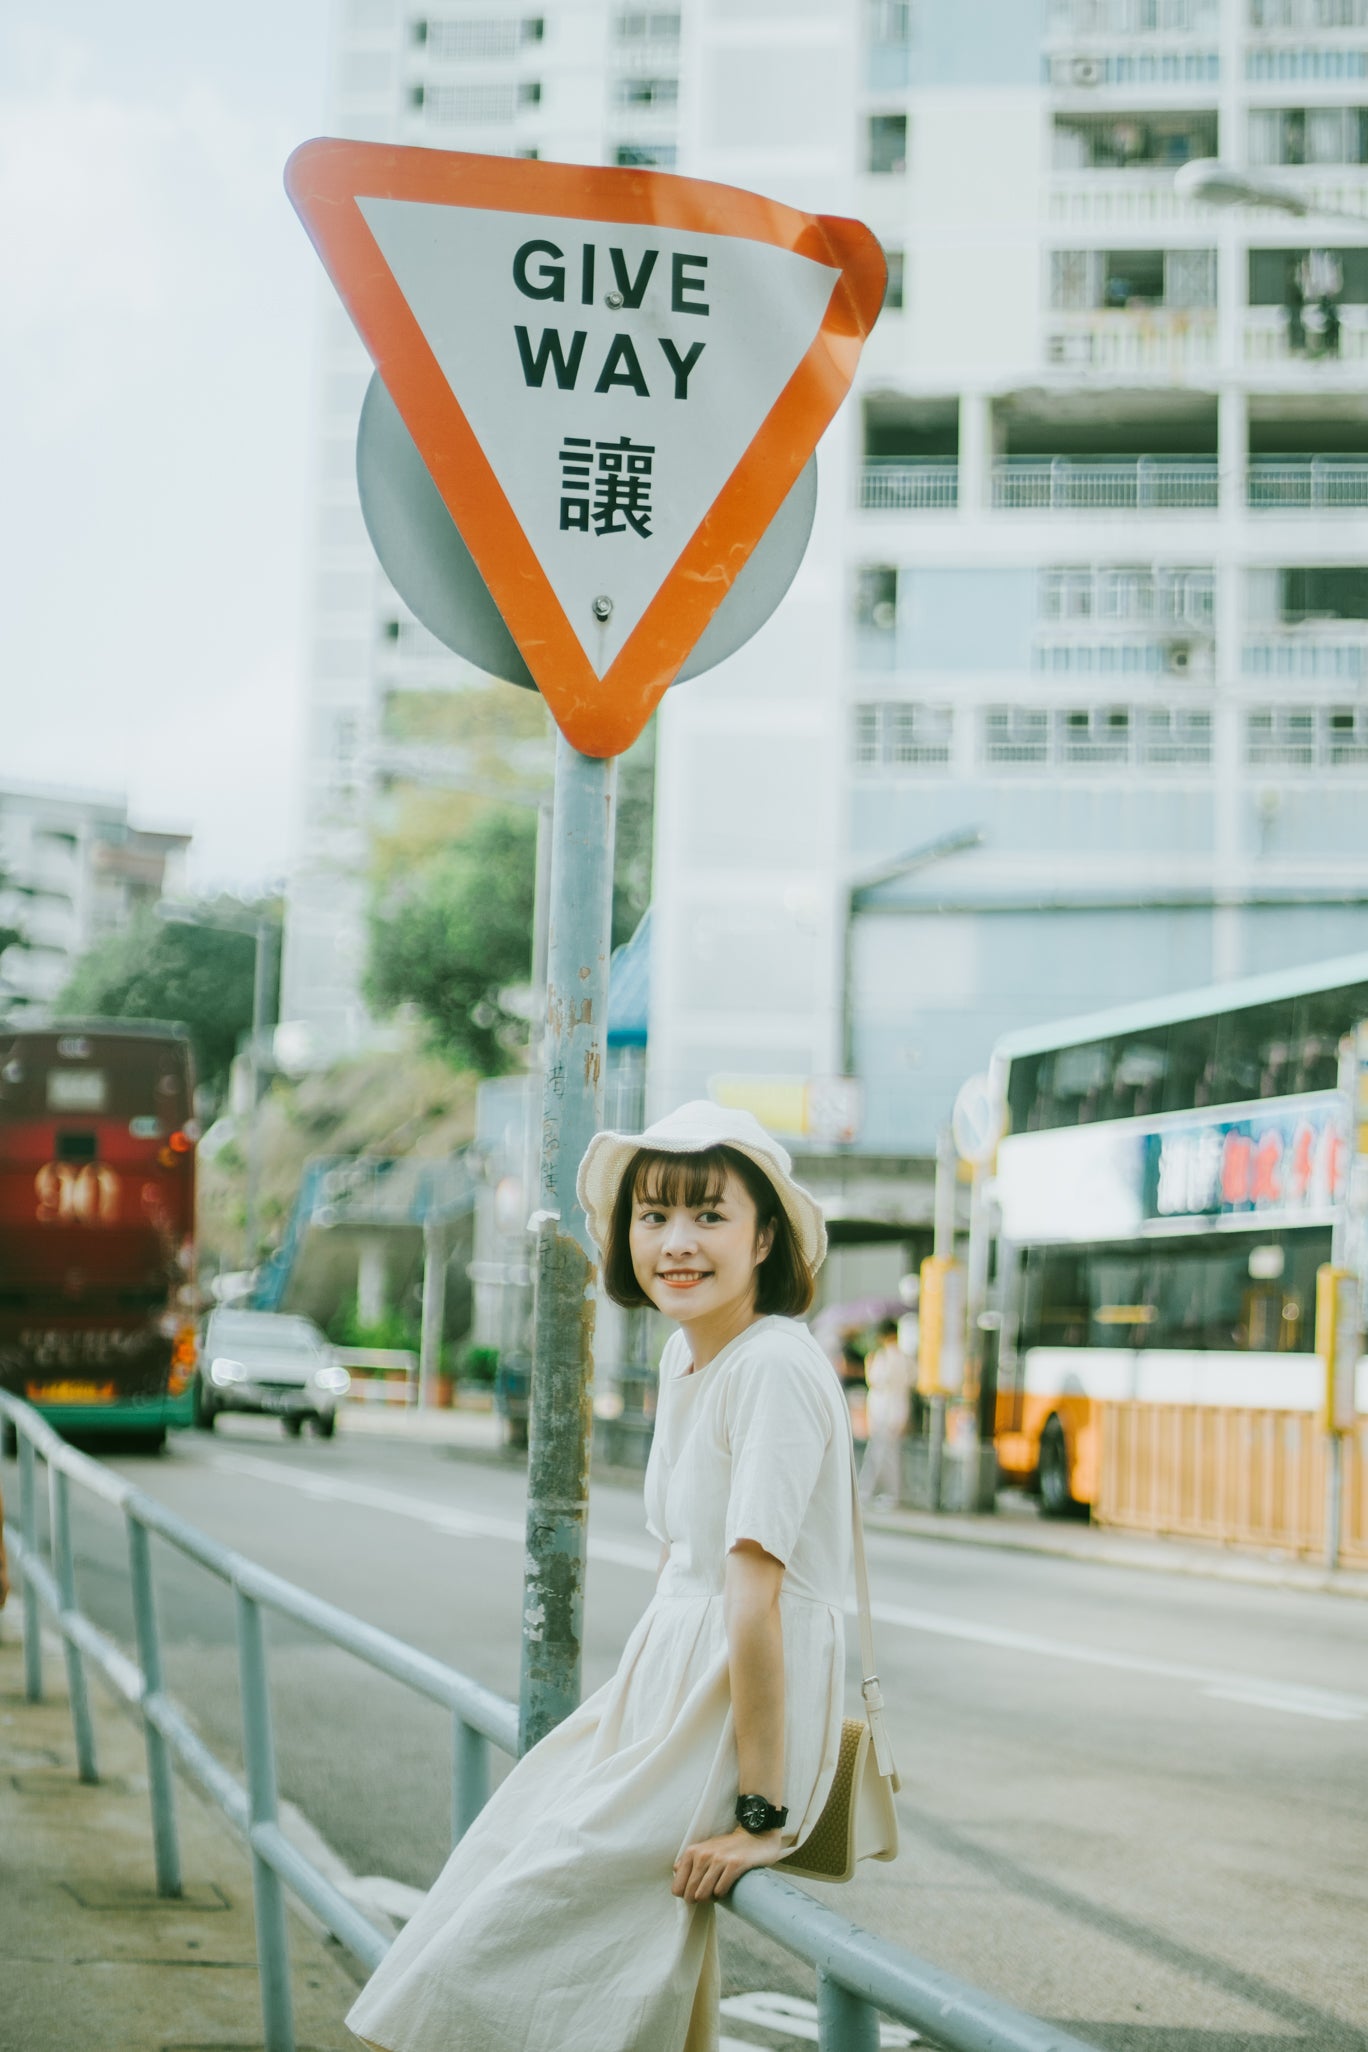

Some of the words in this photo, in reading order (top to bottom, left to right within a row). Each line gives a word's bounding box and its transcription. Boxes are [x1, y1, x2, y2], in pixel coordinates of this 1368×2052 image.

[513, 239, 710, 317] GIVE
[513, 325, 706, 400] WAY
[559, 436, 656, 539] 讓
